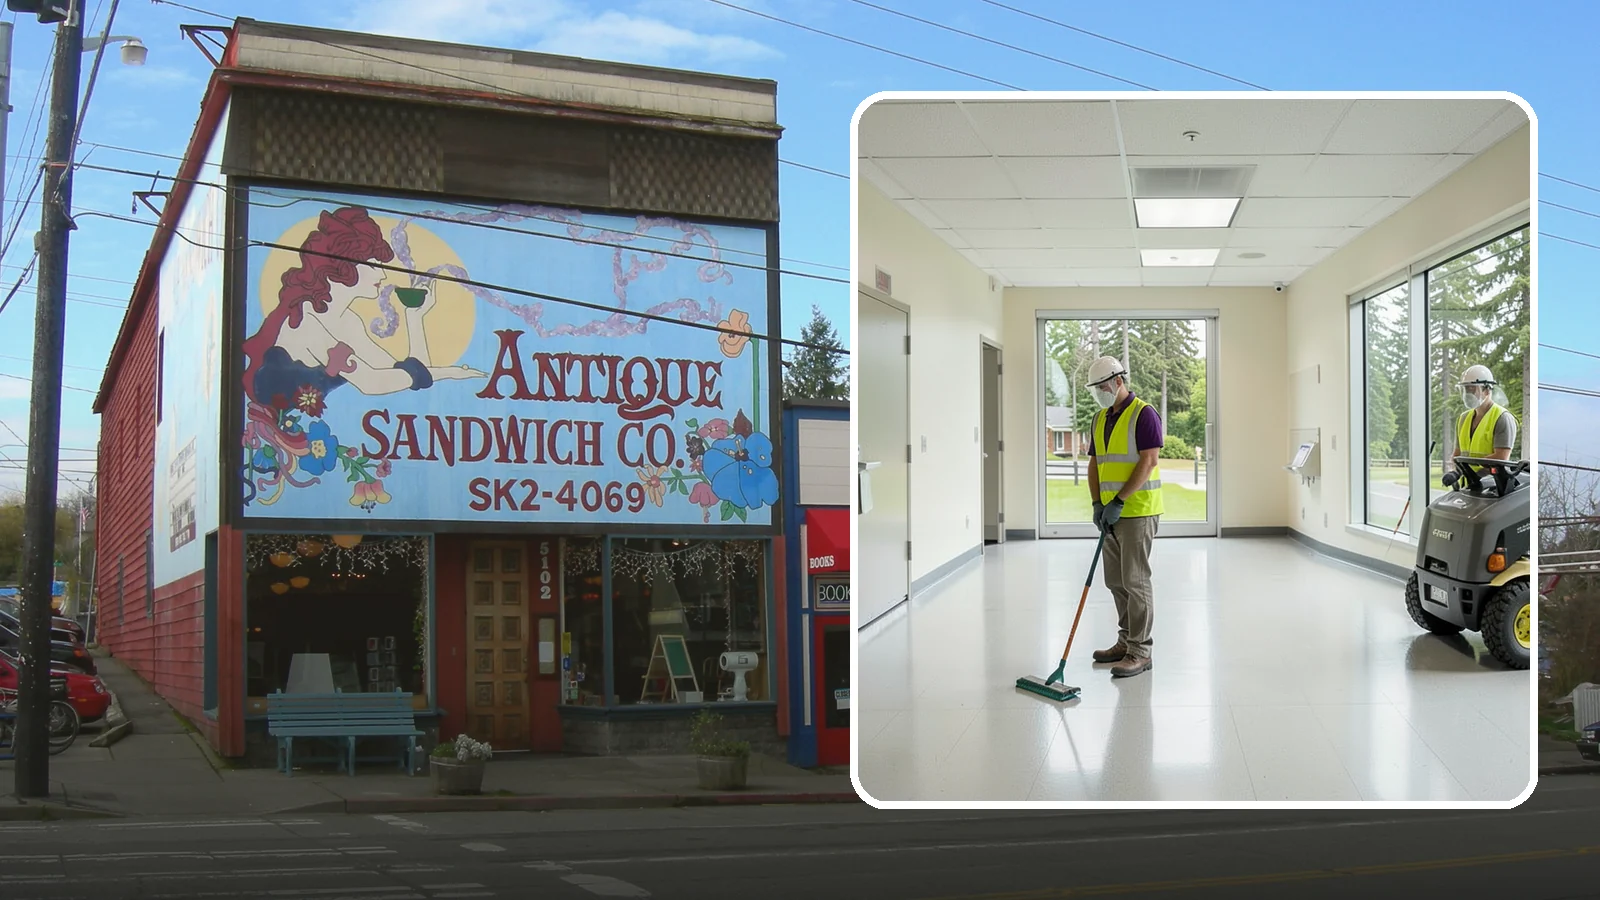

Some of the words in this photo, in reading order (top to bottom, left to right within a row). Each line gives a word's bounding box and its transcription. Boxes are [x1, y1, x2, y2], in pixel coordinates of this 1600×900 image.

[475, 329, 724, 421] ANTIQUE
[361, 408, 604, 467] SANDWICH
[617, 421, 685, 469] CO.
[468, 477, 646, 513] SK2-4069
[540, 541, 551, 600] 5102
[809, 555, 835, 569] BOOKS
